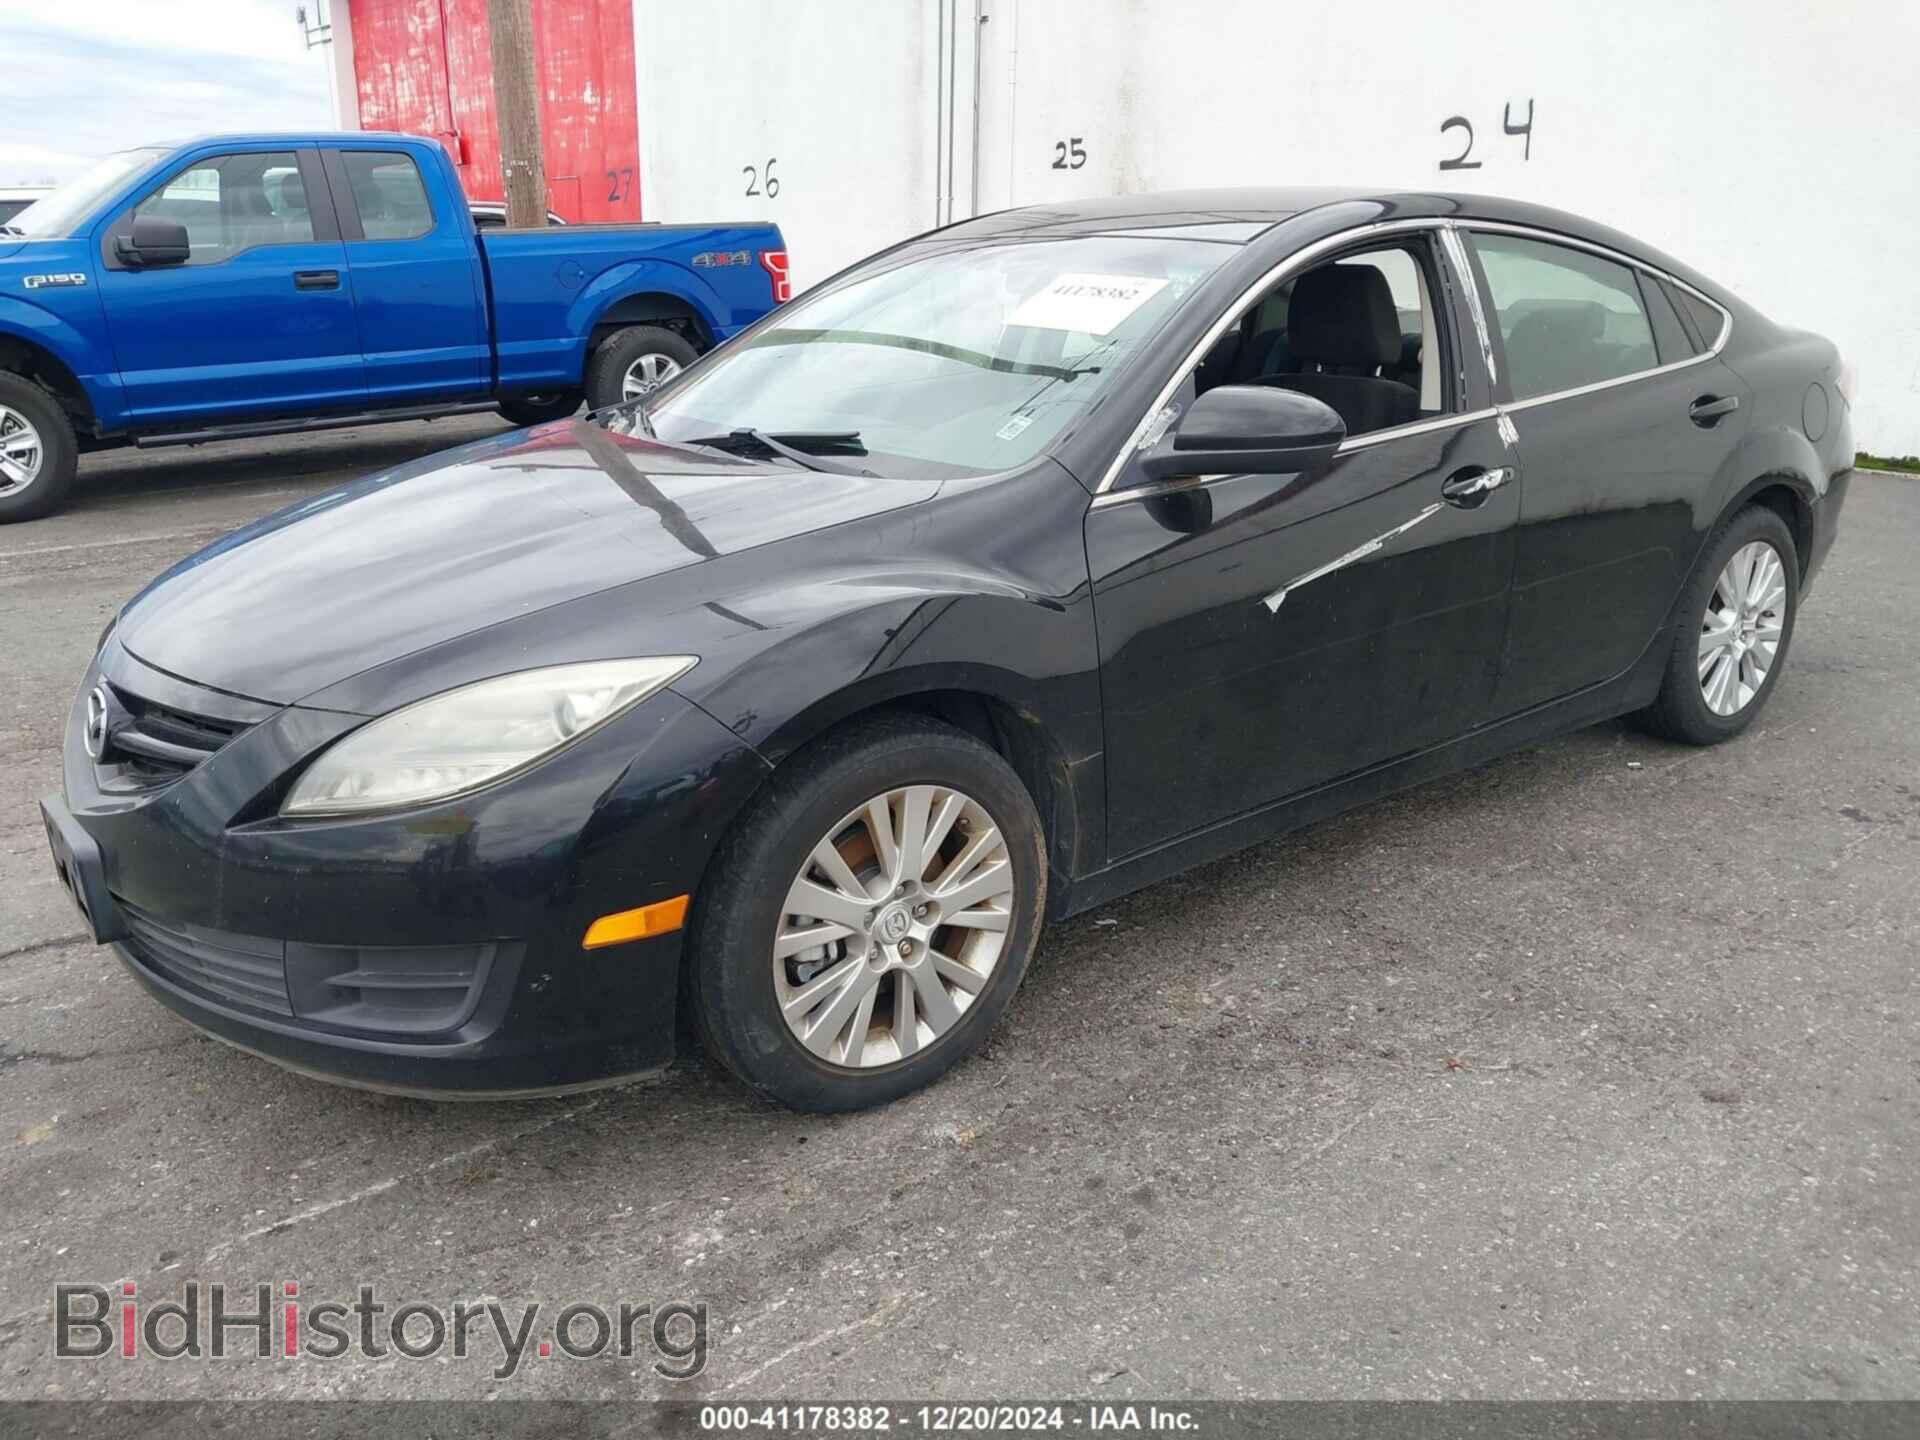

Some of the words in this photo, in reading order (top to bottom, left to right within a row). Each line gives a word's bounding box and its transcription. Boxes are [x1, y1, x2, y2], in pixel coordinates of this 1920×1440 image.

[1052, 137, 1087, 169] 25
[1439, 98, 1534, 170] 24
[607, 166, 633, 203] 27
[743, 158, 780, 199] 26
